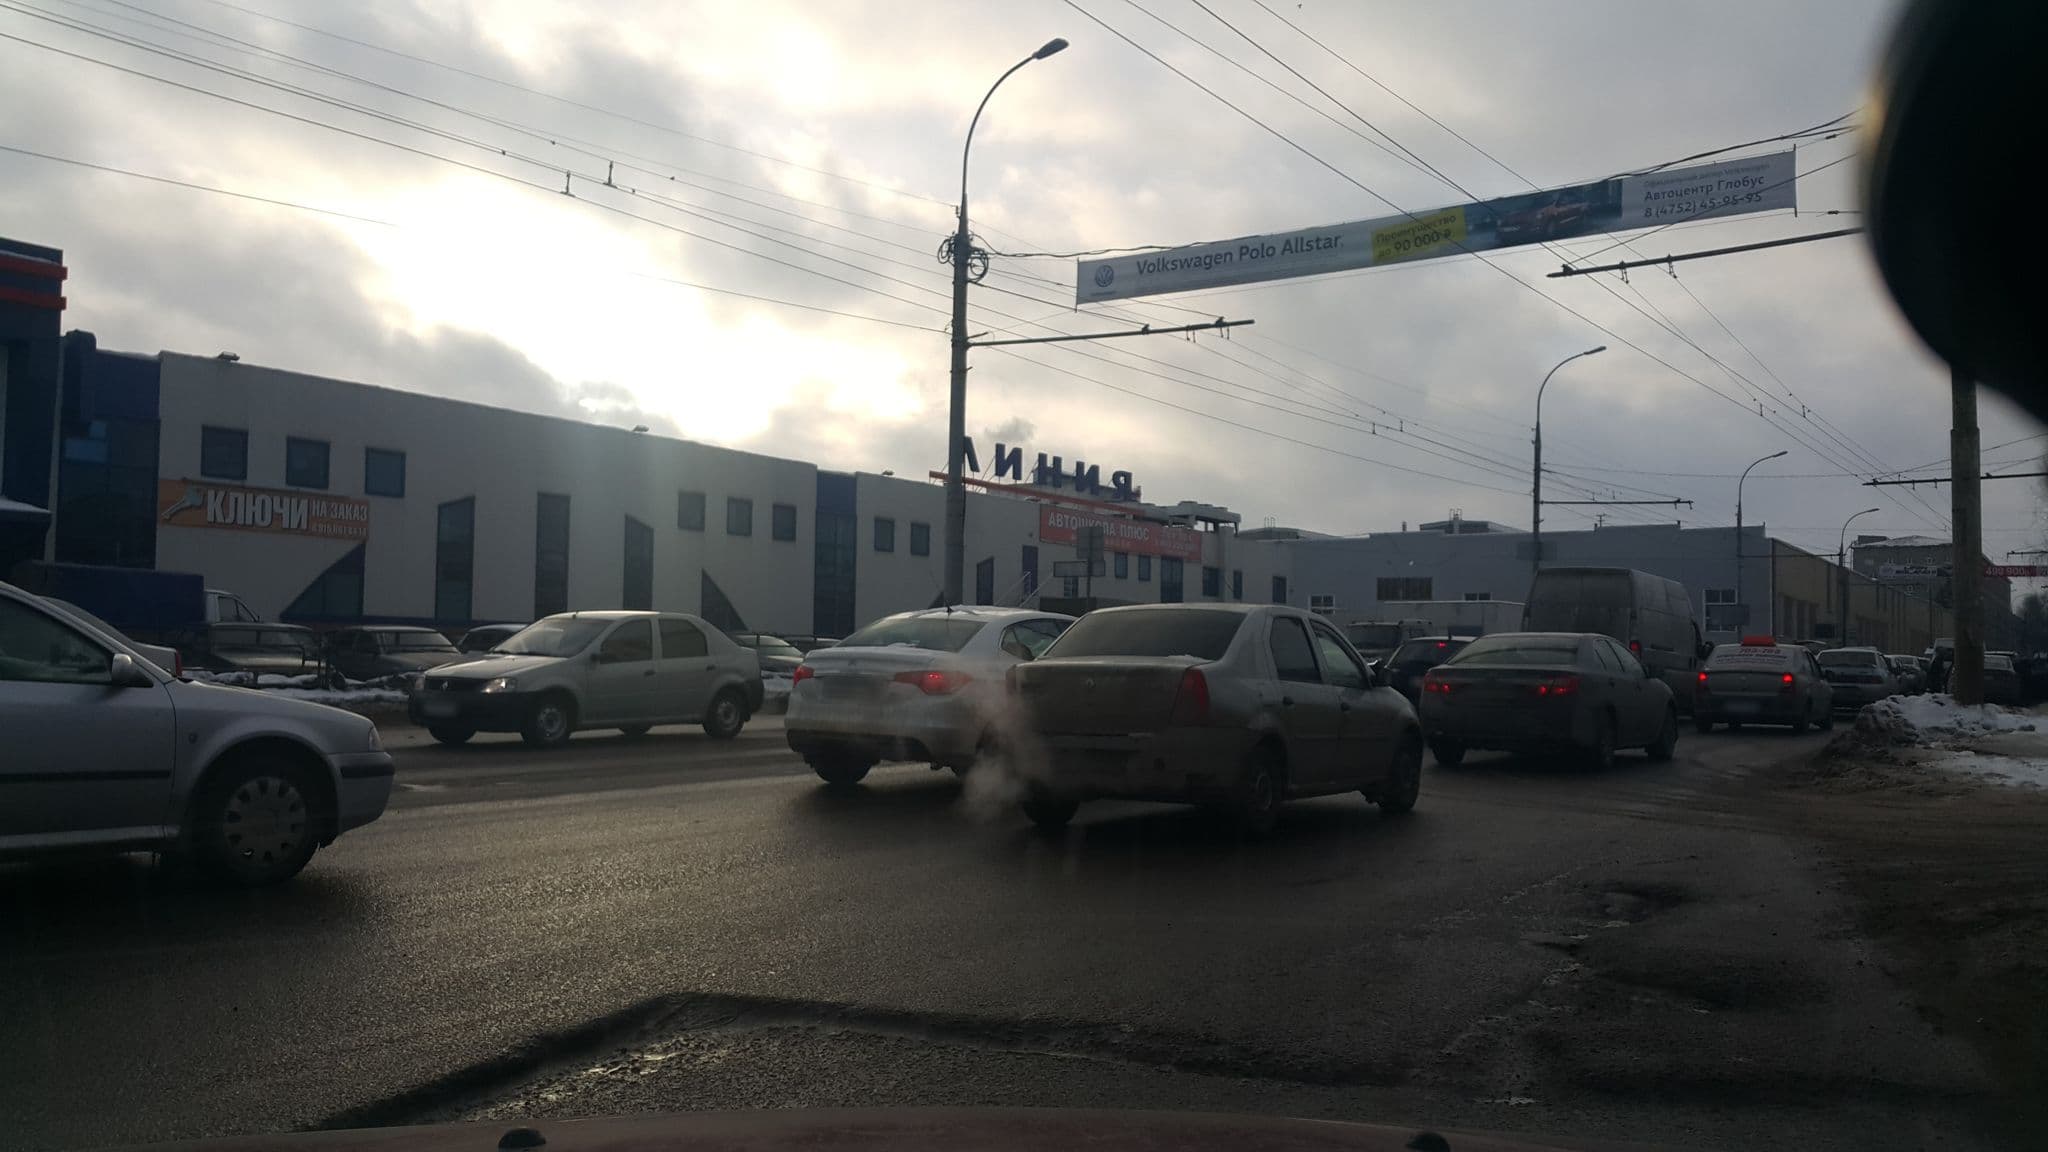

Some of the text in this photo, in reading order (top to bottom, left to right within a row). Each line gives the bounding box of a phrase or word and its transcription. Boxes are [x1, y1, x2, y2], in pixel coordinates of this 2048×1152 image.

[1644, 176, 1766, 202] Автоцентр Глобус
[1644, 207, 1653, 218] 8
[1655, 201, 1697, 218] (4752)
[1394, 240, 1411, 251] 90
[1414, 231, 1441, 247] 000
[1136, 252, 1233, 275] Volkswagen
[1239, 241, 1277, 261] Polo
[206, 489, 309, 530] КЛЮЧИ
[311, 499, 327, 517] НА
[330, 502, 368, 521] ЗАКАЗ
[1119, 525, 1150, 541] ПЛЮС
